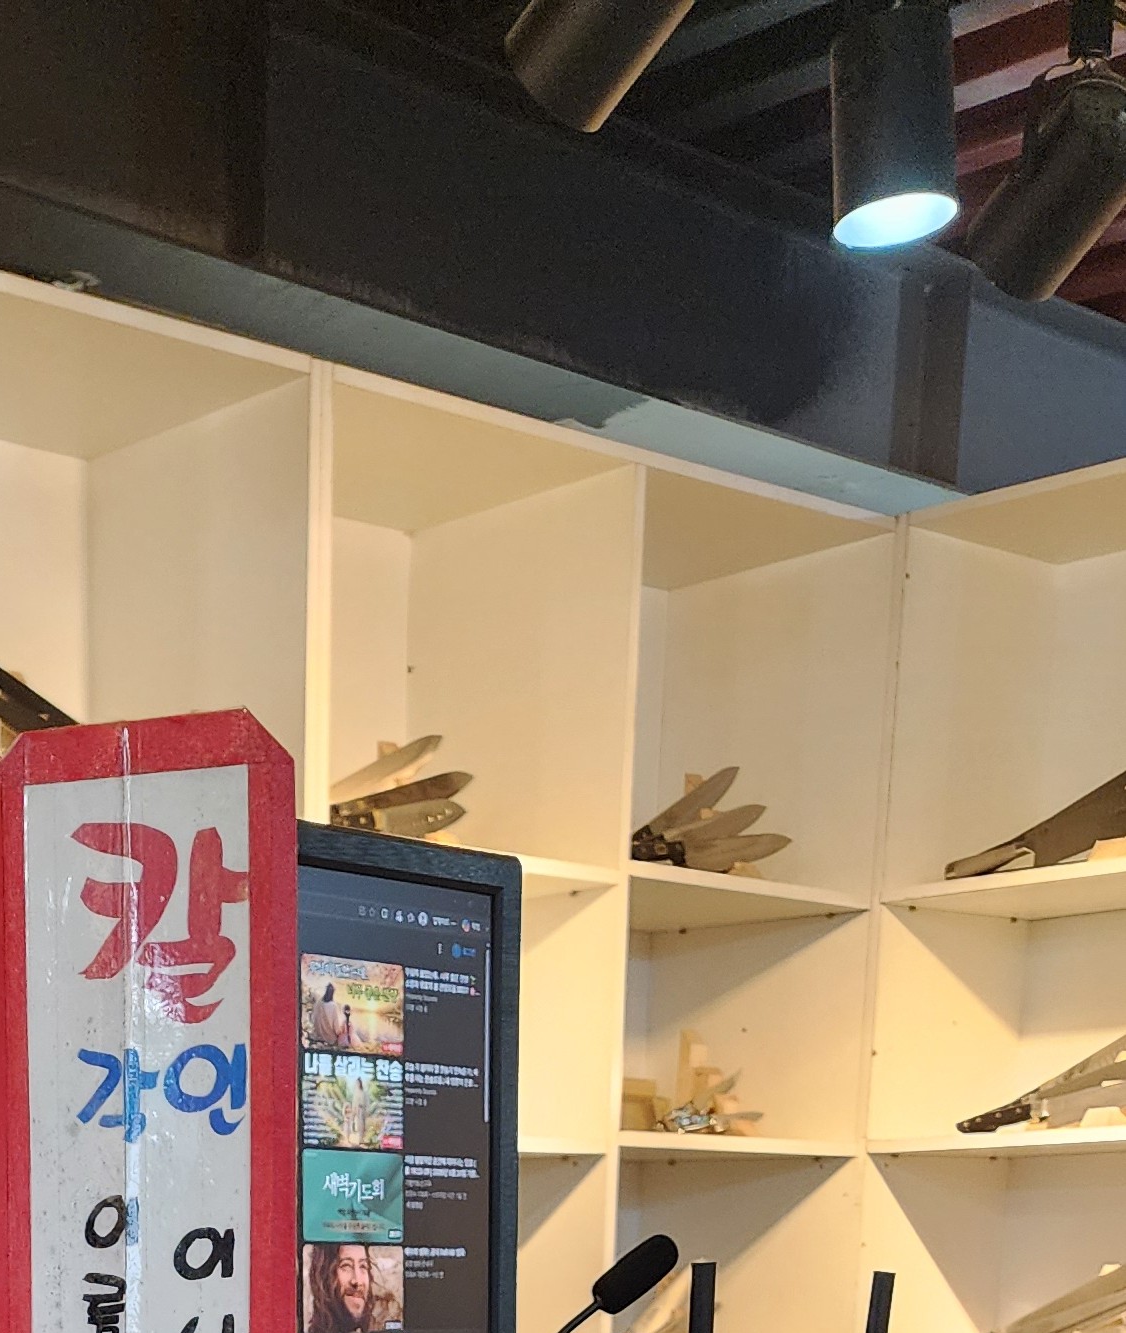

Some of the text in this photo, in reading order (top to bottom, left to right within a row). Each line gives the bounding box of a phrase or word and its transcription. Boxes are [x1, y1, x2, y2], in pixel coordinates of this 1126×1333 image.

[70, 821, 248, 1024] 칼
[76, 1043, 246, 1142] 각인
[375, 1058, 404, 1081] 찬송
[322, 1171, 385, 1203] 새벽기도회
